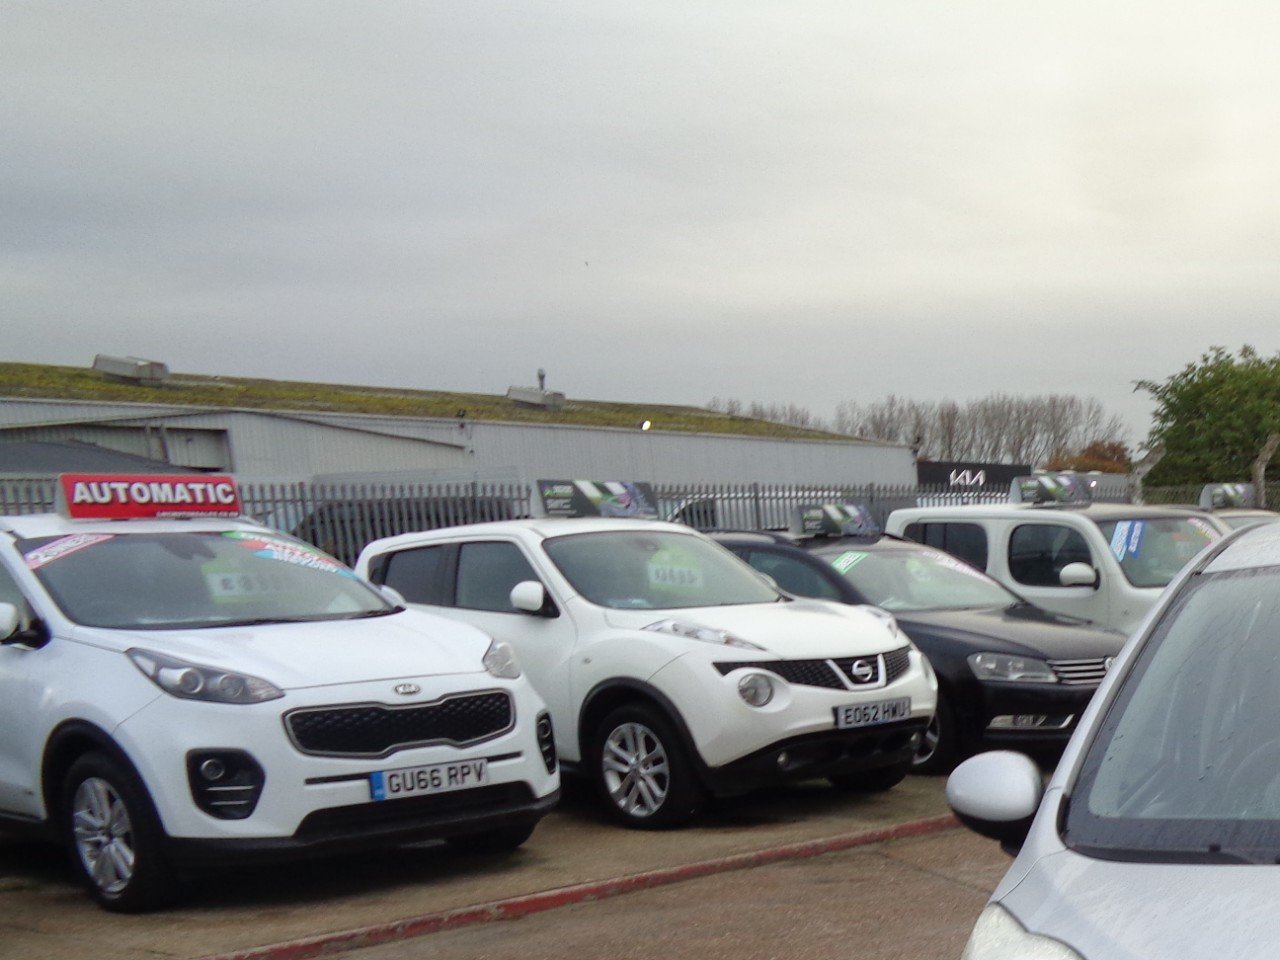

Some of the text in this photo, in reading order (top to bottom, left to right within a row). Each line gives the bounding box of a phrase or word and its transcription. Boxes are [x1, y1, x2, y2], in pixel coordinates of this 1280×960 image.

[73, 481, 236, 504] AUTOMATIC
[387, 762, 485, 793] GU66 RPV
